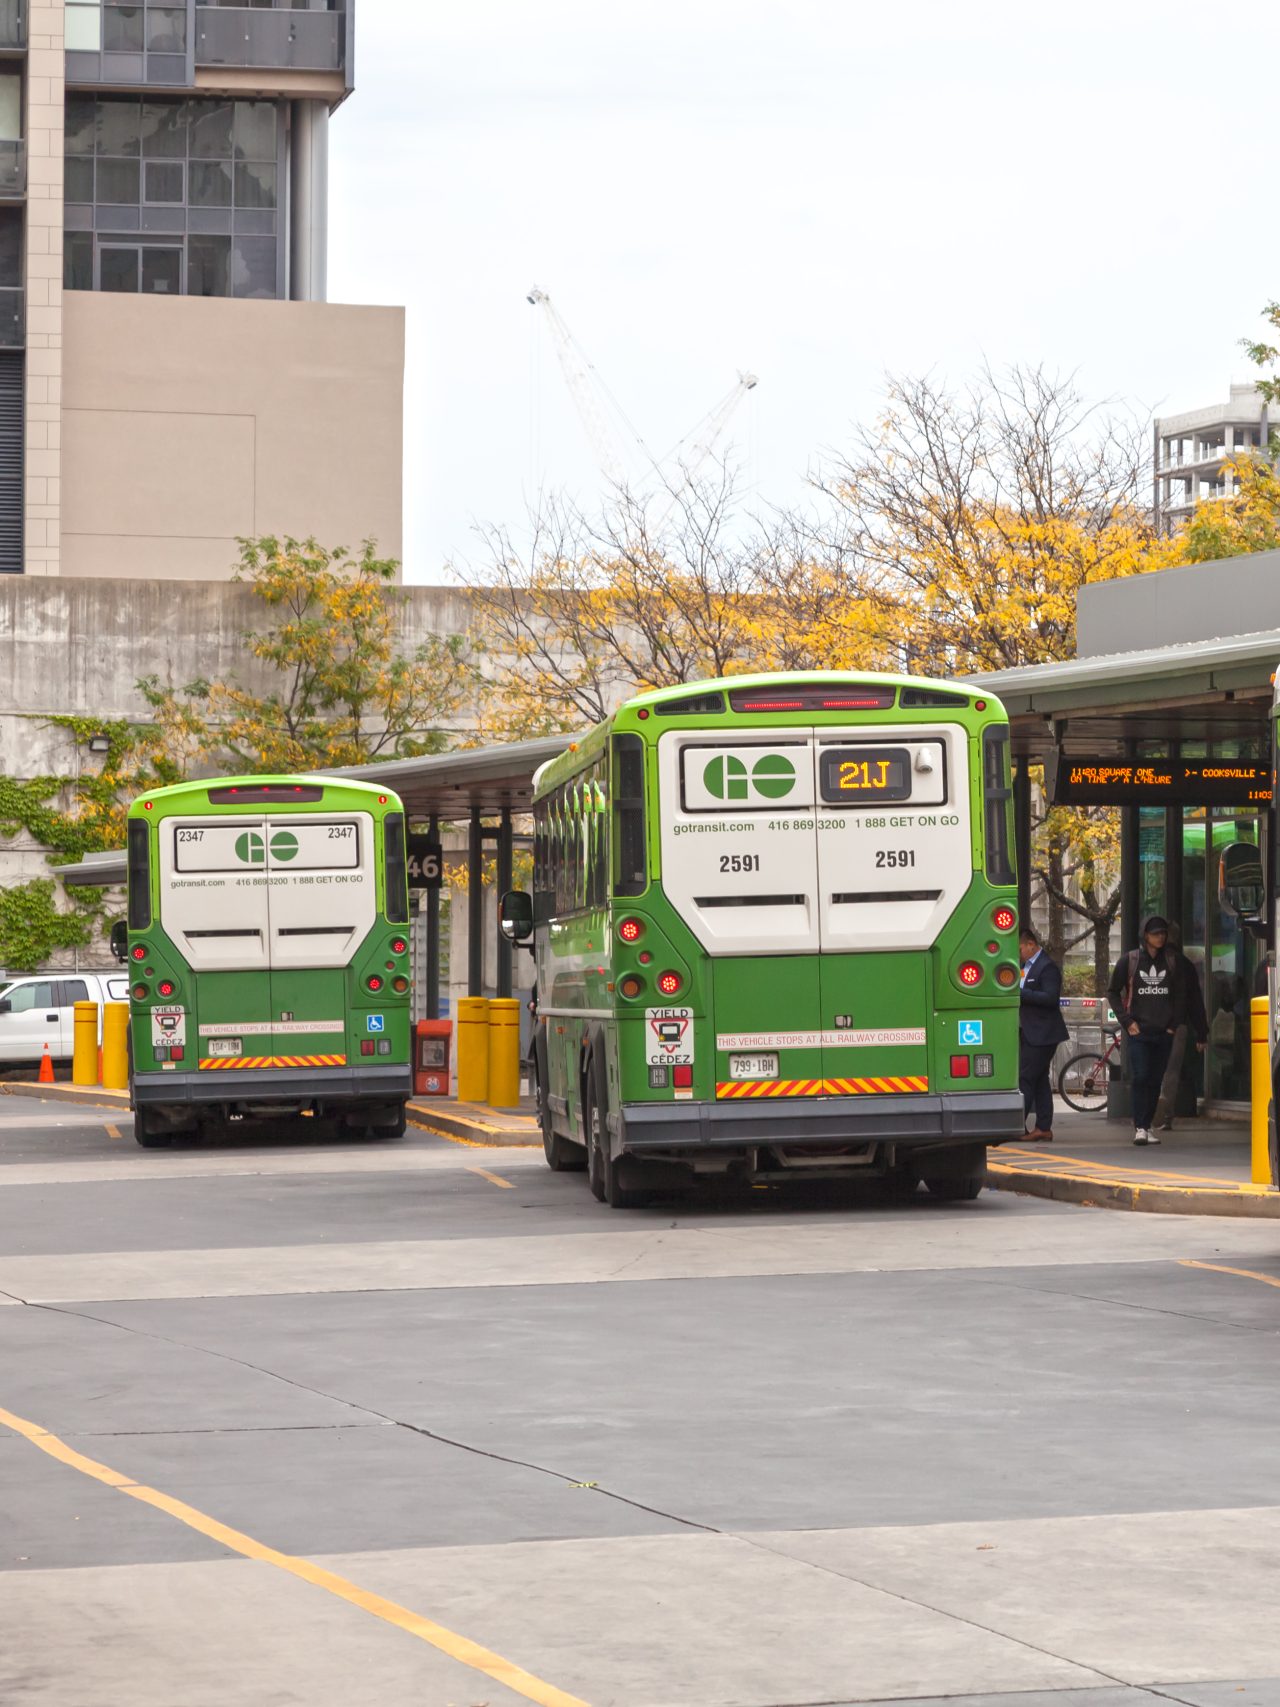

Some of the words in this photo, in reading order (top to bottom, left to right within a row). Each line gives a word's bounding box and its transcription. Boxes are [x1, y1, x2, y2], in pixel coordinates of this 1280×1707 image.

[703, 754, 796, 800] GO
[839, 761, 890, 789] 21J
[1099, 768, 1132, 776] SQUARE
[1137, 768, 1154, 776] ONE
[1202, 768, 1256, 778] COOKSVILLE
[673, 821, 755, 835] gotransit.com
[768, 820, 790, 830] 416
[793, 820, 814, 830] 869
[817, 819, 846, 830] 3200
[856, 818, 860, 828] 1
[865, 818, 886, 828] 888
[890, 817, 914, 827] GET
[918, 816, 936, 826] ON
[940, 815, 959, 826] GO
[179, 830, 204, 842] 2347
[328, 827, 353, 839] 2347
[235, 831, 299, 863] GO
[720, 854, 760, 872] 2591
[875, 850, 915, 868] 2591
[408, 854, 438, 878] 46
[171, 879, 225, 889] gotransit.com
[1138, 985, 1168, 994] adidas
[650, 1009, 689, 1018] YIELD
[718, 1038, 736, 1047] THIS
[738, 1037, 773, 1046] VEHICLE
[776, 1036, 803, 1045] STOPS
[805, 1035, 818, 1044] AT
[820, 1035, 834, 1043] ALL
[837, 1033, 875, 1043] RAILWAY
[878, 1032, 926, 1042] CROSSINGS
[651, 1054, 690, 1064] CÉDEZ
[734, 1060, 750, 1072] 799
